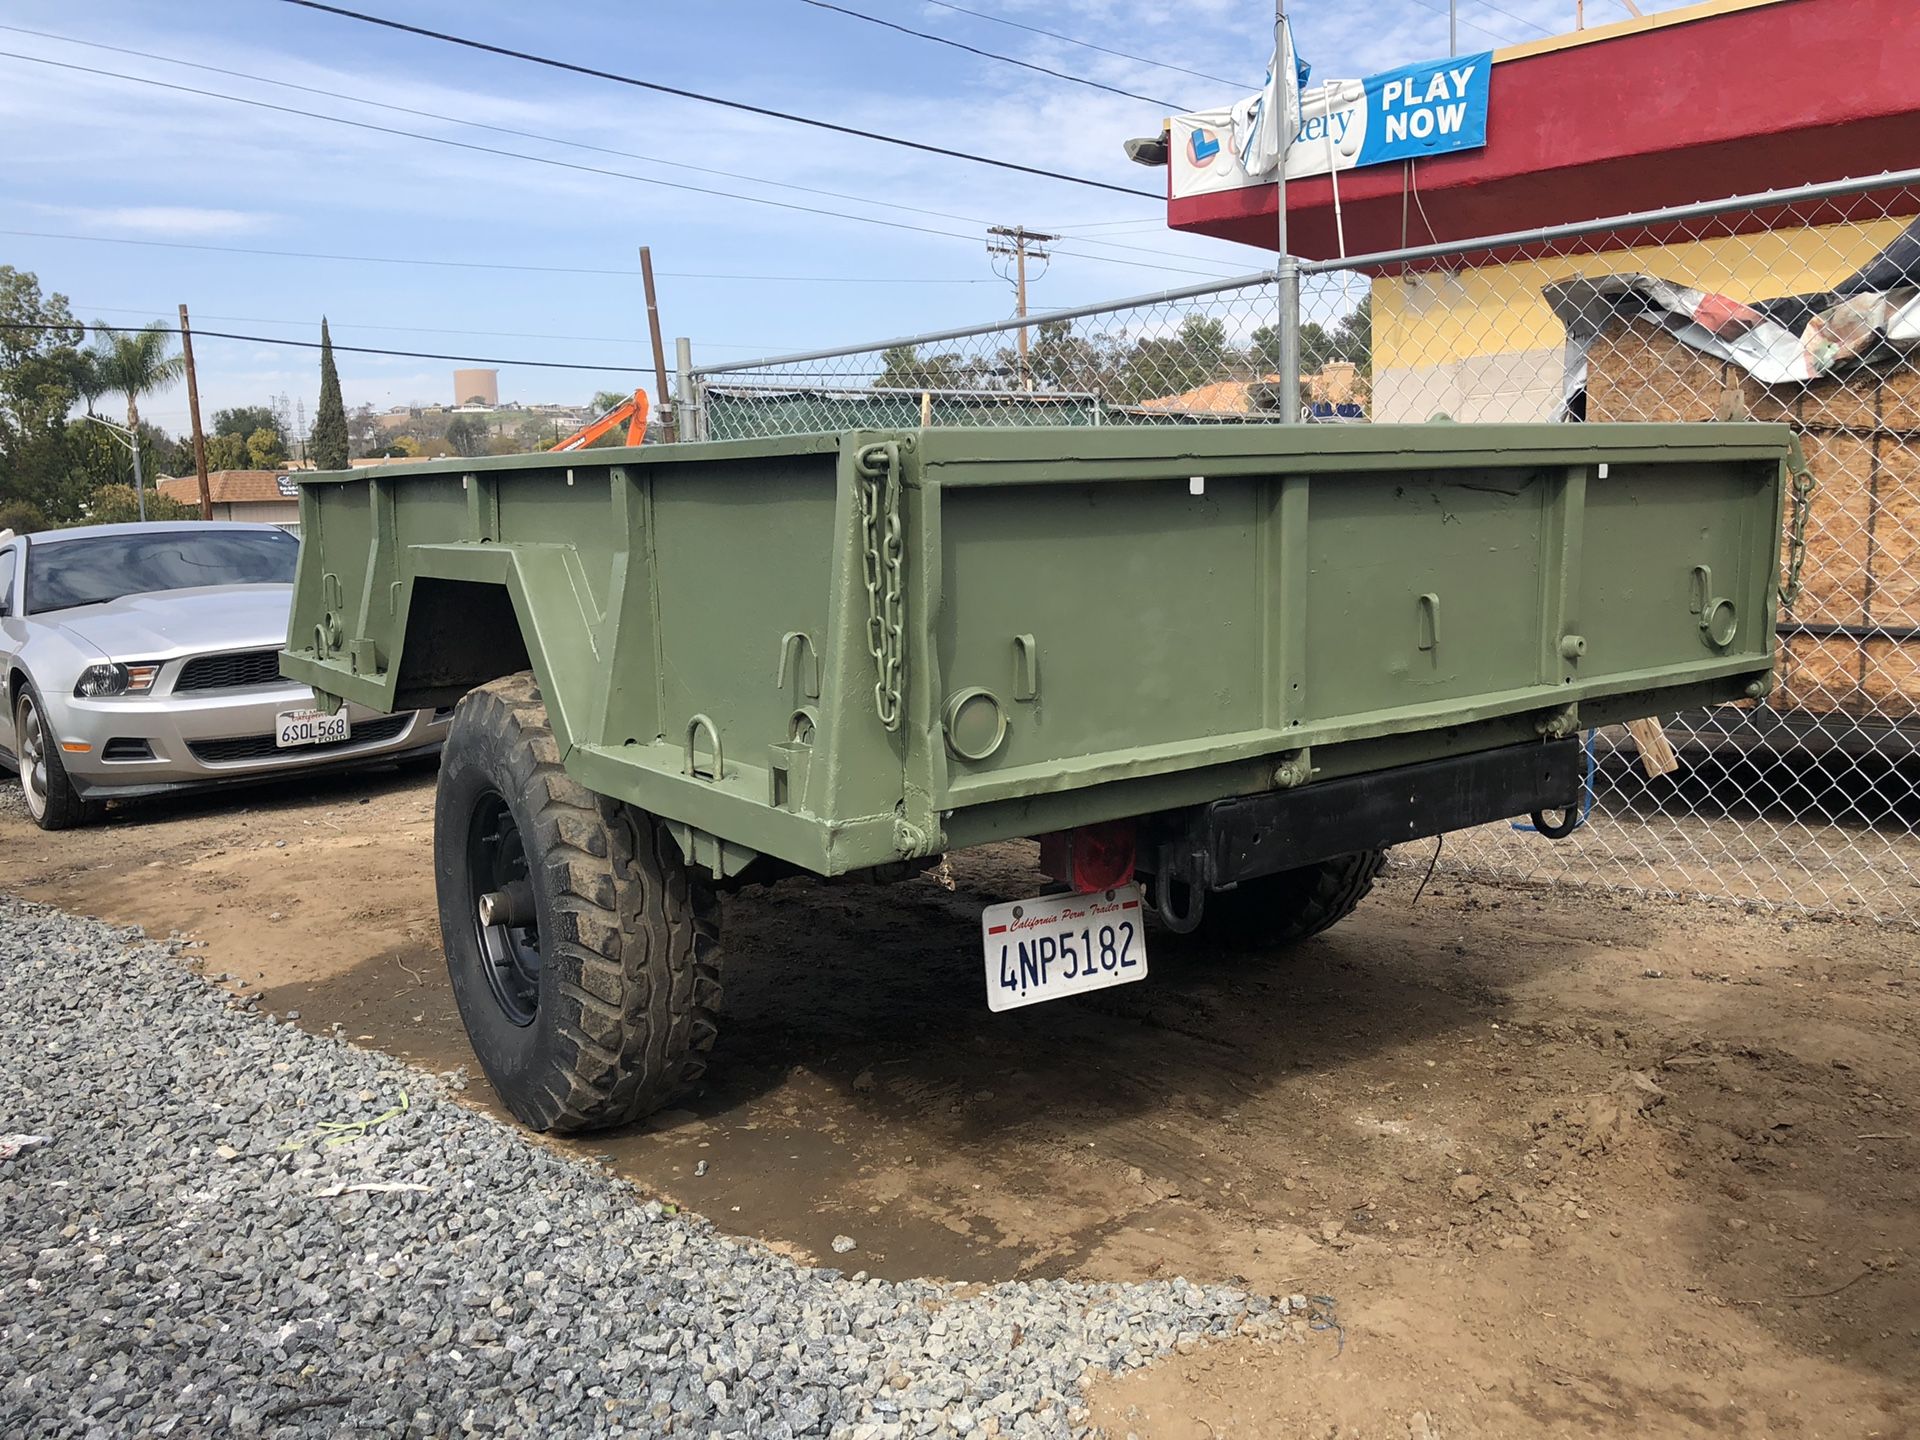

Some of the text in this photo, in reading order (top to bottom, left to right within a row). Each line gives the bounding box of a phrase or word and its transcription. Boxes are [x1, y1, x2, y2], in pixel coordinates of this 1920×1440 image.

[1382, 66, 1475, 111] PLAY
[1385, 102, 1467, 144] NOW
[1010, 903, 1119, 932] California Perm Trailer
[1000, 921, 1137, 991] 4NP5182
